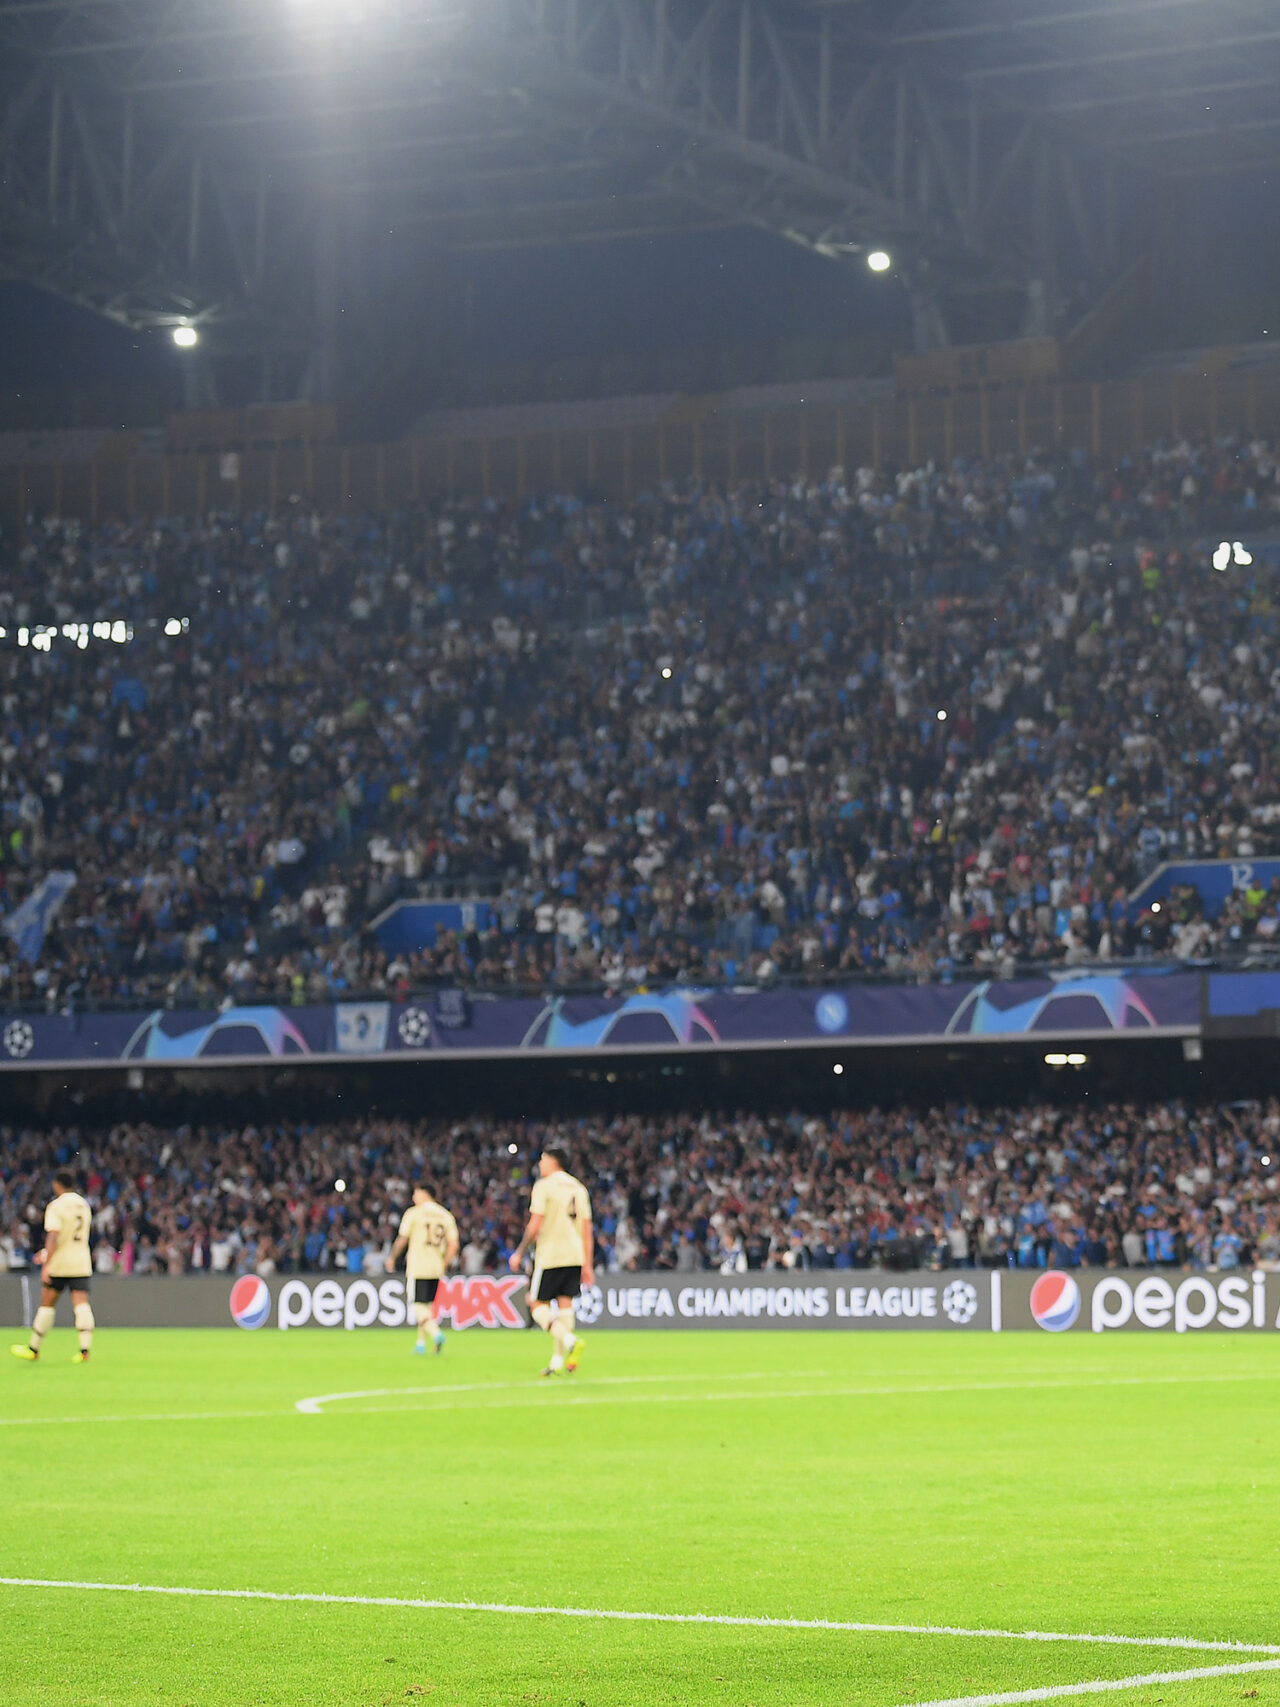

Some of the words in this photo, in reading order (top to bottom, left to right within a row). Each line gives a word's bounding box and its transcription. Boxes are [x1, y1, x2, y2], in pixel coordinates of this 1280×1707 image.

[1231, 864, 1254, 890] 12
[567, 1196, 578, 1220] 4
[73, 1214, 84, 1242] 2
[425, 1222, 447, 1248] 19
[431, 1274, 528, 1329] MAX
[606, 1287, 676, 1317] UEFA
[678, 1287, 830, 1318] CHAMPIONS
[835, 1287, 939, 1318] LEAGUE
[1091, 1269, 1266, 1333] pepsi
